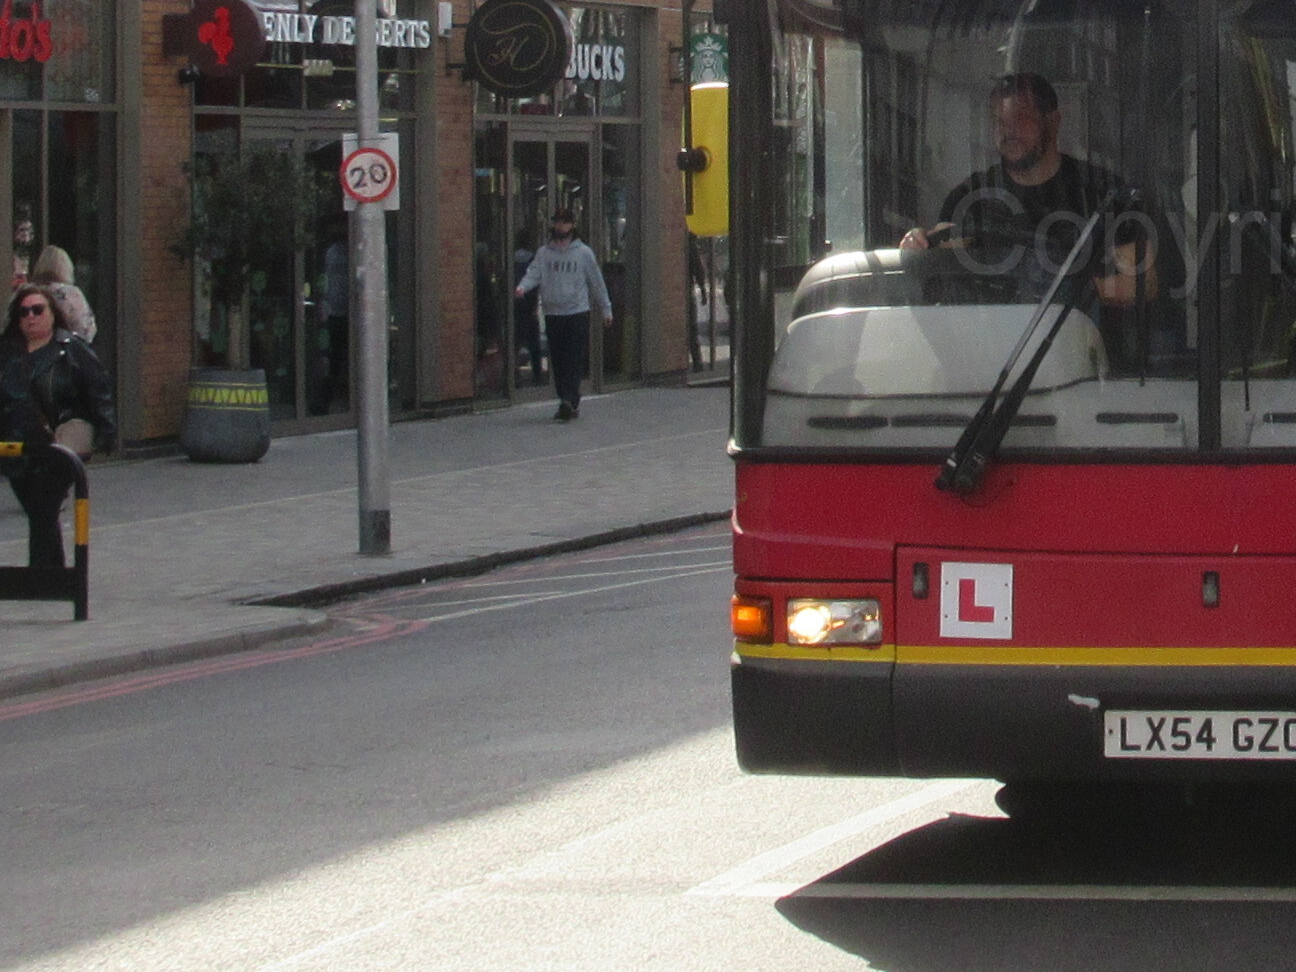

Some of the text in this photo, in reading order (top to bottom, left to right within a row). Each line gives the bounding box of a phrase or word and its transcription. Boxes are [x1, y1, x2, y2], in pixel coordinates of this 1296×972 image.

[322, 16, 431, 48] DEERTS
[350, 164, 388, 189] 20
[959, 578, 995, 621] L
[1120, 716, 1217, 752] LX54
